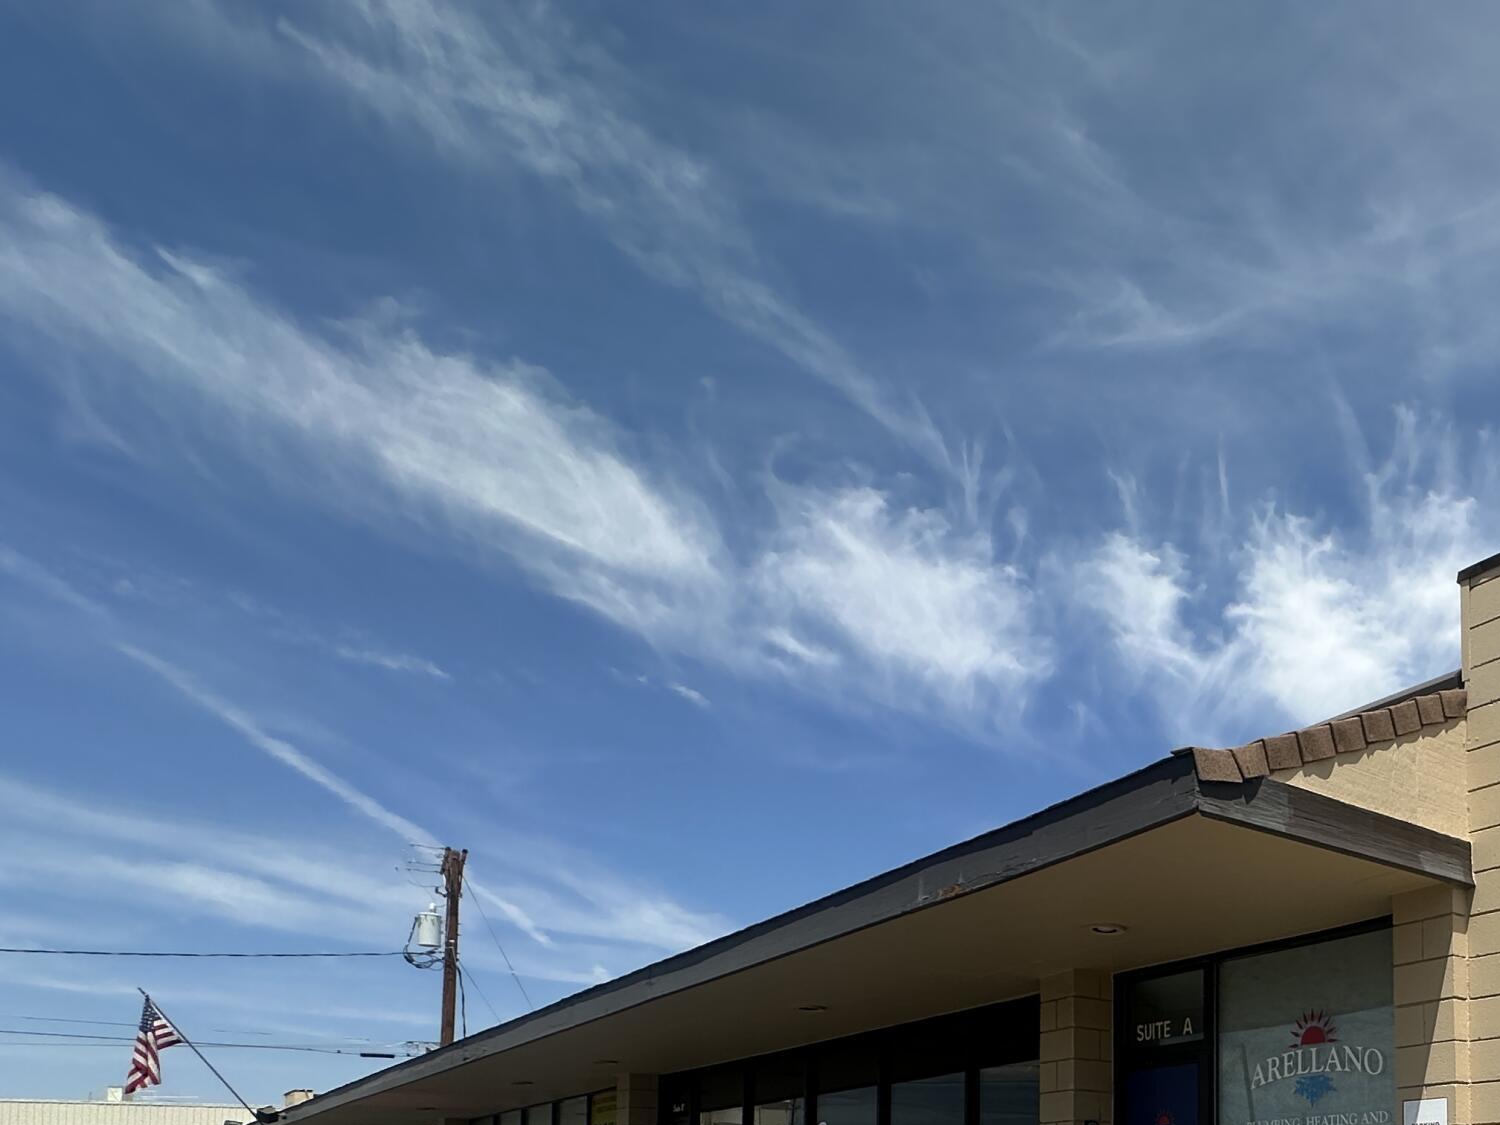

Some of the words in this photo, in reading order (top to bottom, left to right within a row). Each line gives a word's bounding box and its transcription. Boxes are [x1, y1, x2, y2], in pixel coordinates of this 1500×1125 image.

[1136, 1020, 1171, 1041] SUITE
[1183, 1017, 1192, 1035] A
[1251, 1045, 1383, 1089] ARELLANO
[1361, 1110, 1388, 1125] AND
